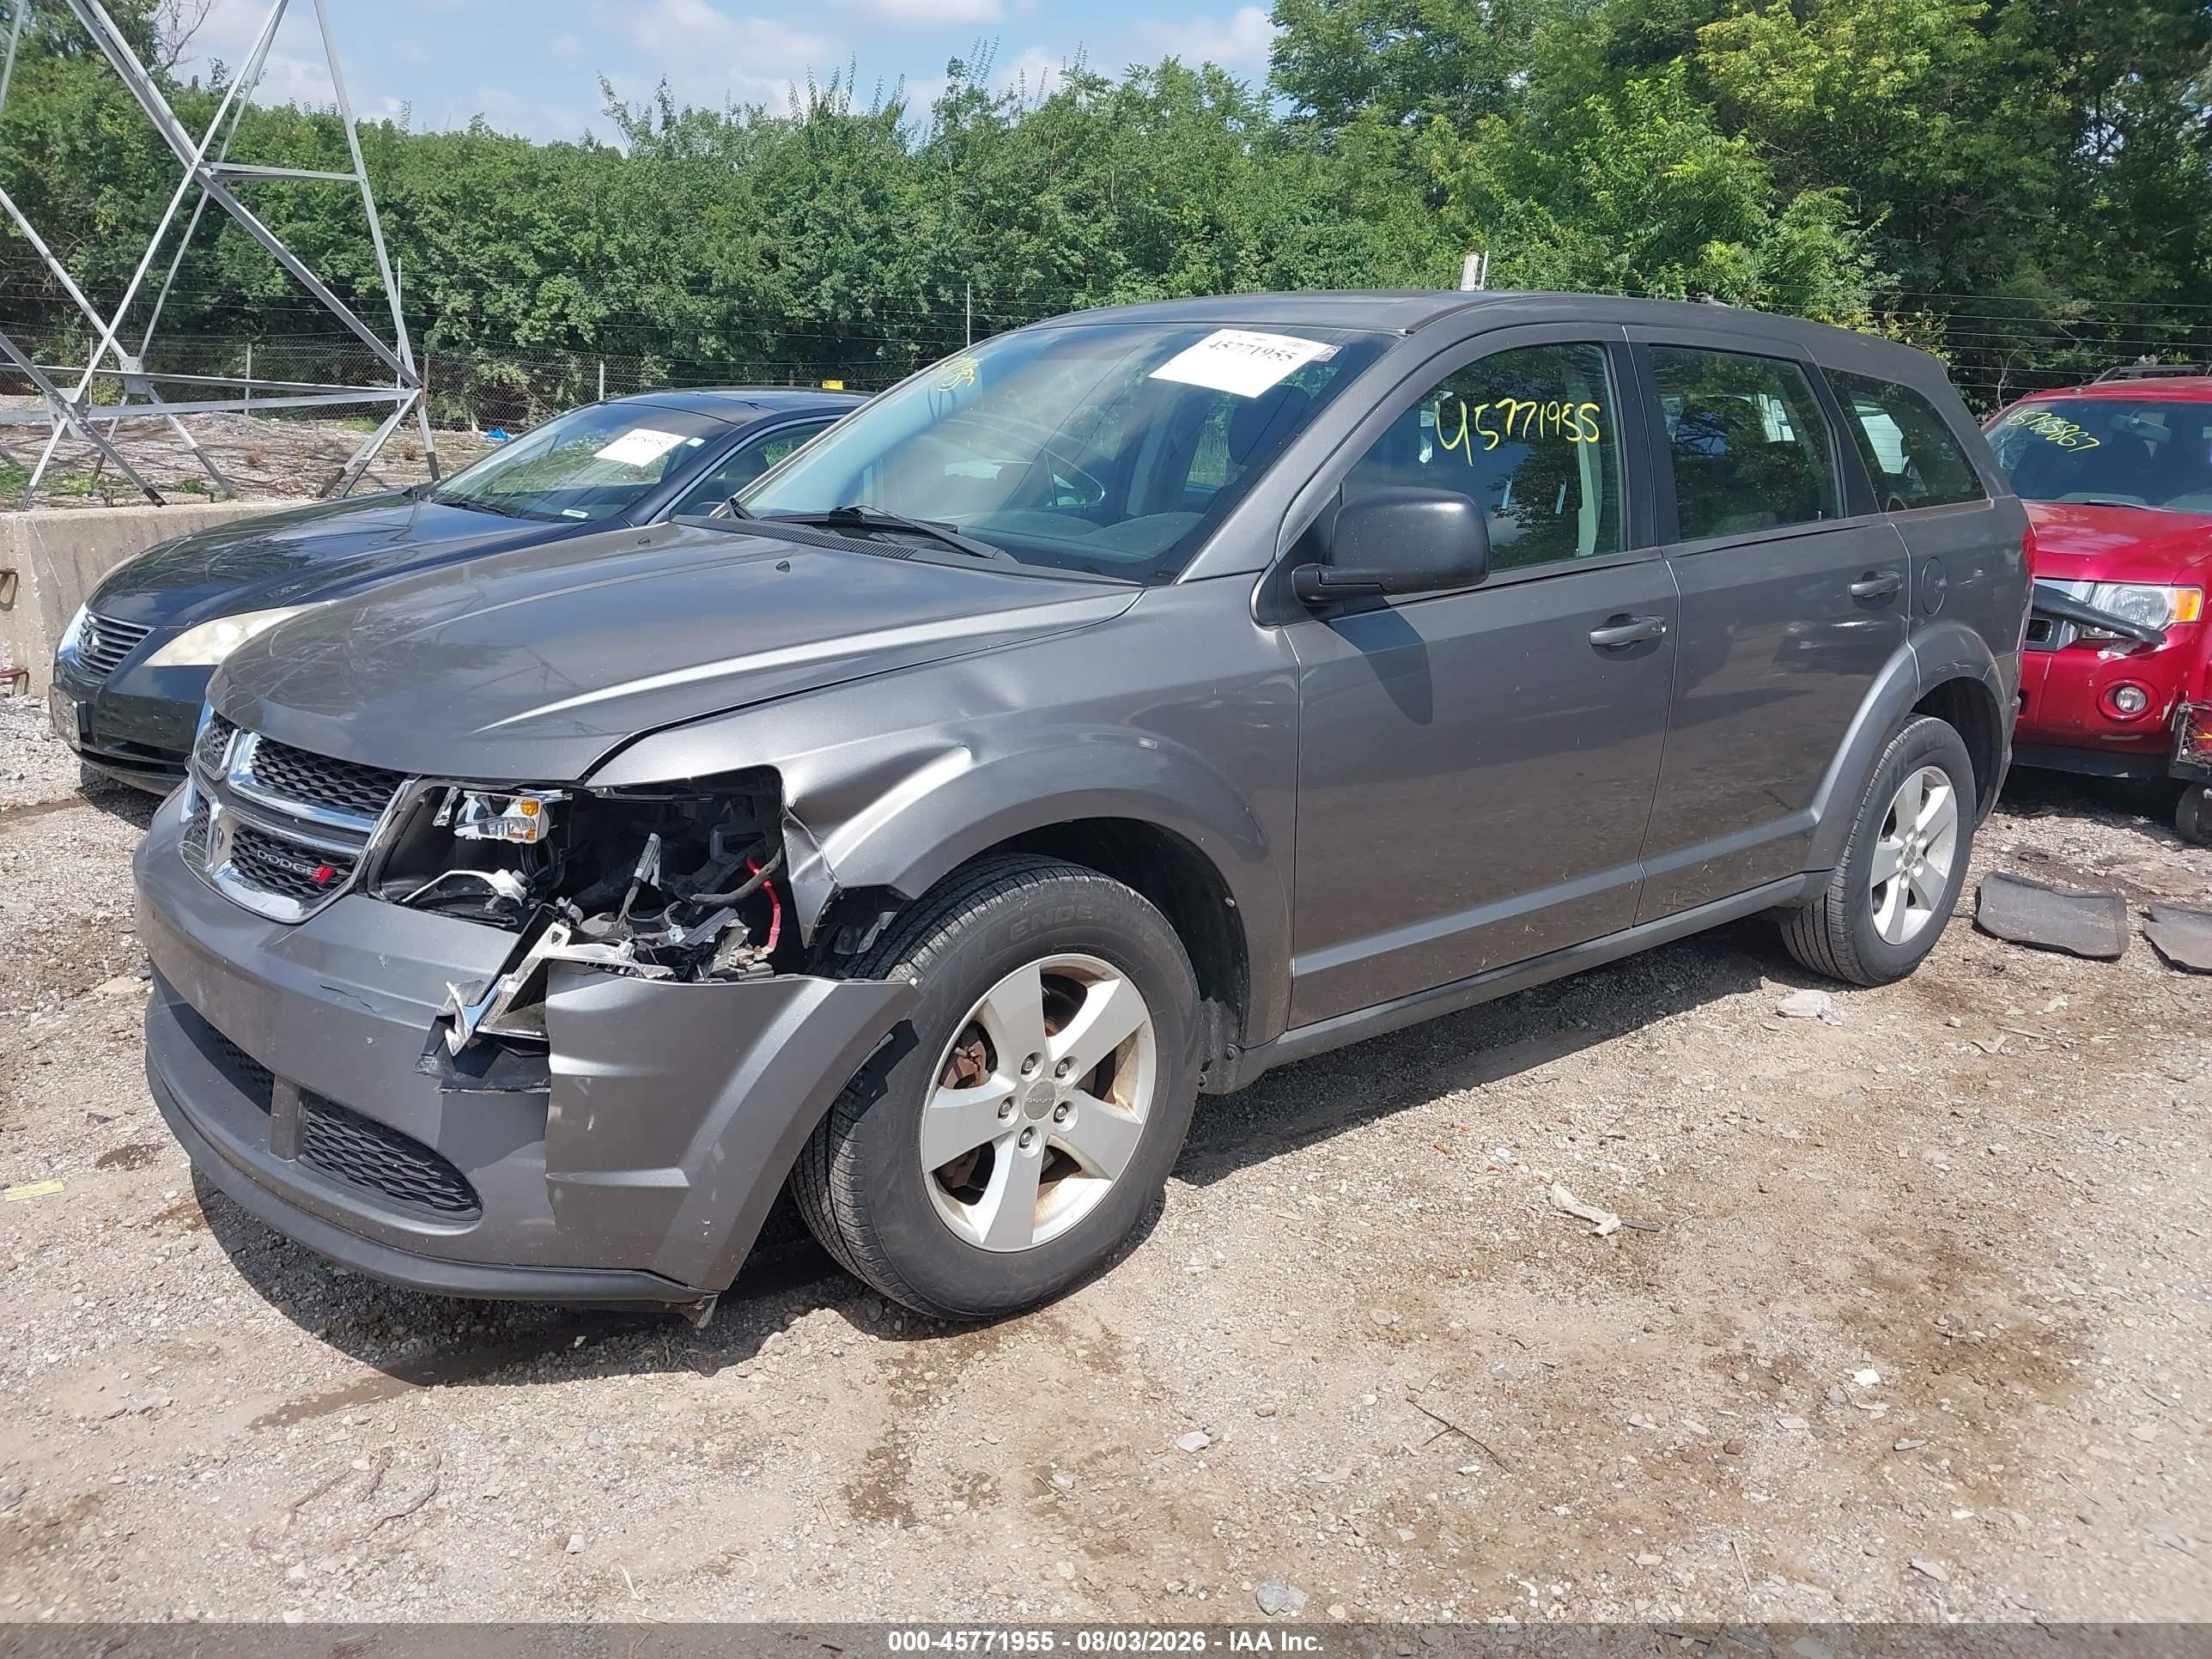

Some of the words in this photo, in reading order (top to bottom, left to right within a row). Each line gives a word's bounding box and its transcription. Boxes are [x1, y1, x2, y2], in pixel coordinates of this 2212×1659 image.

[1208, 340, 1299, 362] 45771955
[1434, 398, 1601, 467] 45771955
[257, 849, 320, 877] DODGE
